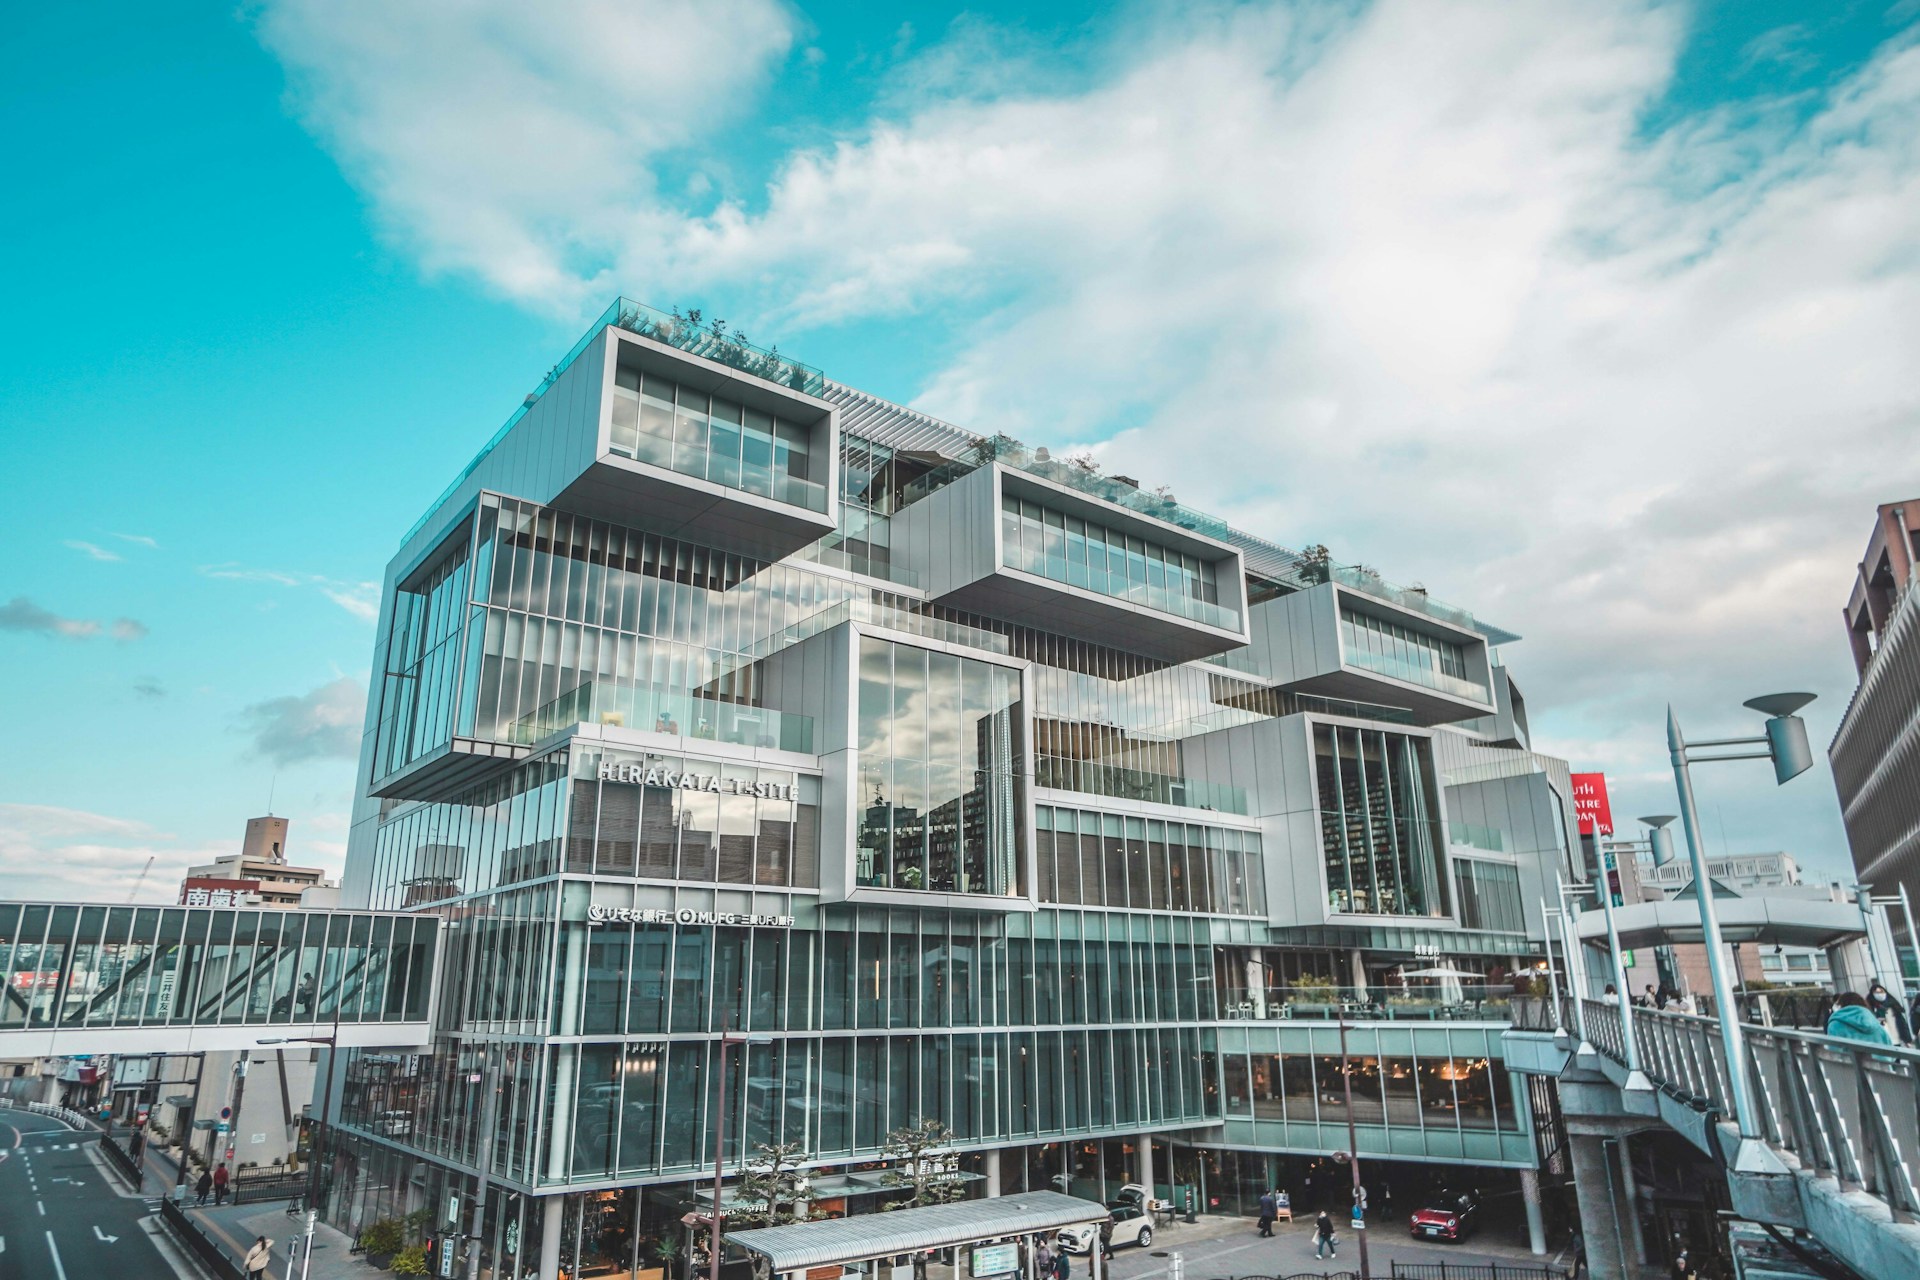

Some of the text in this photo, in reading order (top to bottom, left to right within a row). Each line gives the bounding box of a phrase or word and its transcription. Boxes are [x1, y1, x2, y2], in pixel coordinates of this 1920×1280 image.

[598, 761, 799, 801] HIRAKATA T-SITE
[607, 908, 667, 922] りそな銀行
[698, 911, 796, 926] MUFG 三菱UFJ銀行
